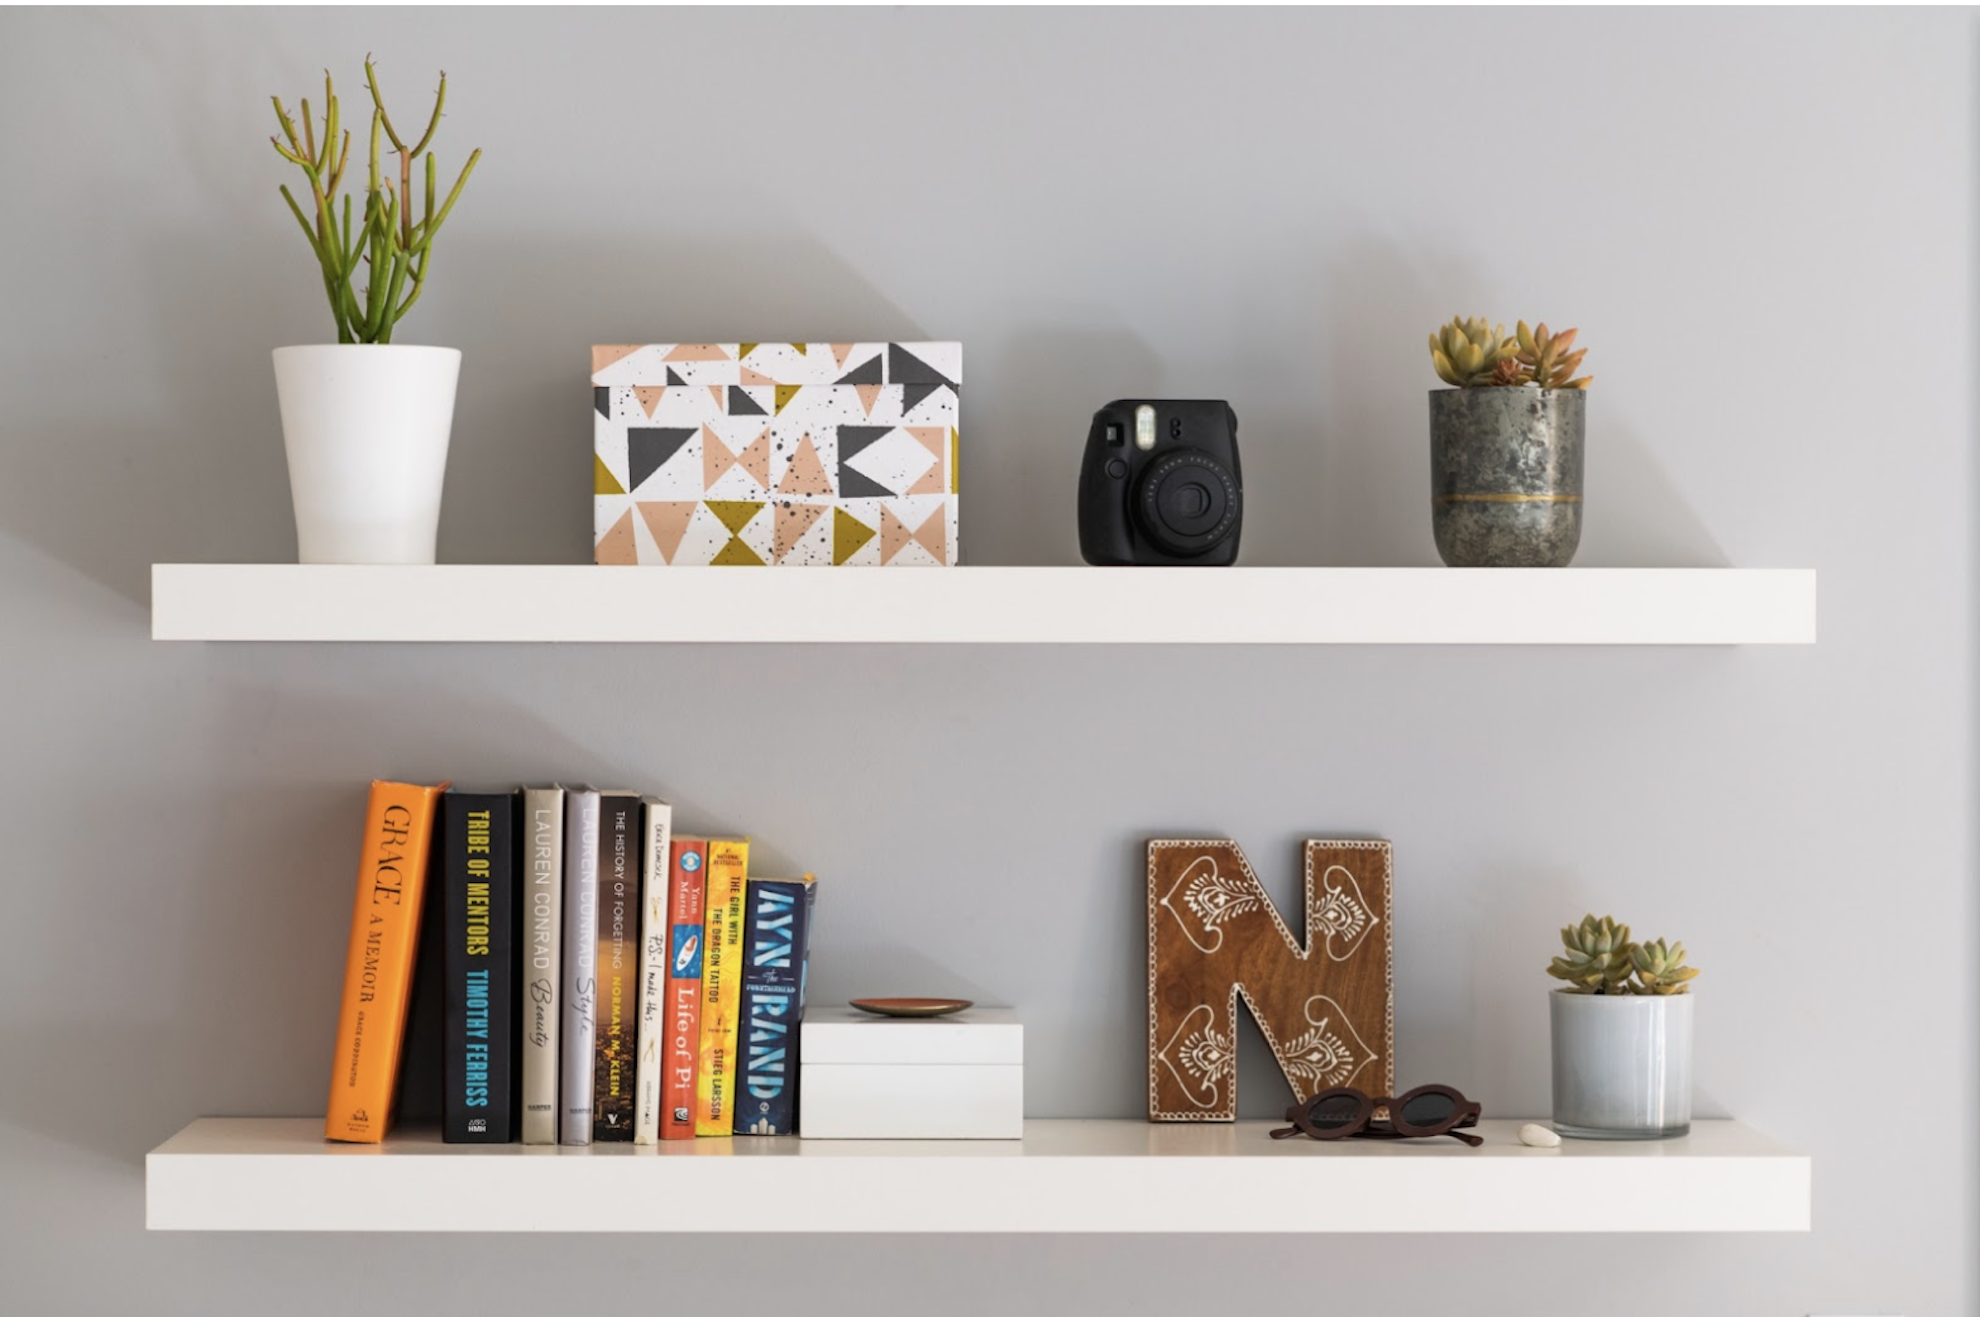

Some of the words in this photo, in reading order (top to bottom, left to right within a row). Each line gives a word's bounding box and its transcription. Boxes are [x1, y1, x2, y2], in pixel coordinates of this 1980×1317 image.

[467, 810, 490, 854] TRIBE
[615, 811, 626, 831] THE
[373, 805, 411, 905] GRACE
[534, 809, 551, 885] LAUREN
[581, 808, 597, 884] LAUREN
[614, 834, 625, 879] HISTORY
[467, 859, 490, 878] OF
[730, 876, 741, 893] THE
[613, 883, 624, 897] OF
[678, 881, 689, 919] Martel
[691, 887, 701, 914] Yann
[729, 896, 740, 918] GIRL
[369, 913, 383, 925] A
[466, 883, 490, 955] MENTORS
[533, 892, 551, 968] CONRAD
[578, 891, 596, 968] CONRAD
[612, 902, 624, 969] FORGETTING
[712, 908, 723, 925] THE
[728, 922, 738, 945] WITH
[753, 888, 795, 968] AYN
[360, 930, 383, 1003] MEMOIR
[710, 928, 722, 967] DRAGON
[466, 969, 489, 1039] TIMOTHY
[611, 976, 622, 1035] NORMAN
[646, 972, 656, 997] made
[709, 969, 720, 1003] TATTOO
[355, 1011, 365, 1036] GRACE
[529, 978, 553, 1048] Beauty
[571, 976, 596, 1037] Style
[677, 988, 695, 1032] Life
[675, 1036, 692, 1061] of
[712, 1048, 724, 1076] STIEG
[747, 994, 788, 1099] RAND
[465, 1044, 488, 1107] FERRISS
[610, 1060, 620, 1096] KLEIN
[674, 1066, 692, 1089] Pi
[710, 1079, 722, 1121] LARSSON
